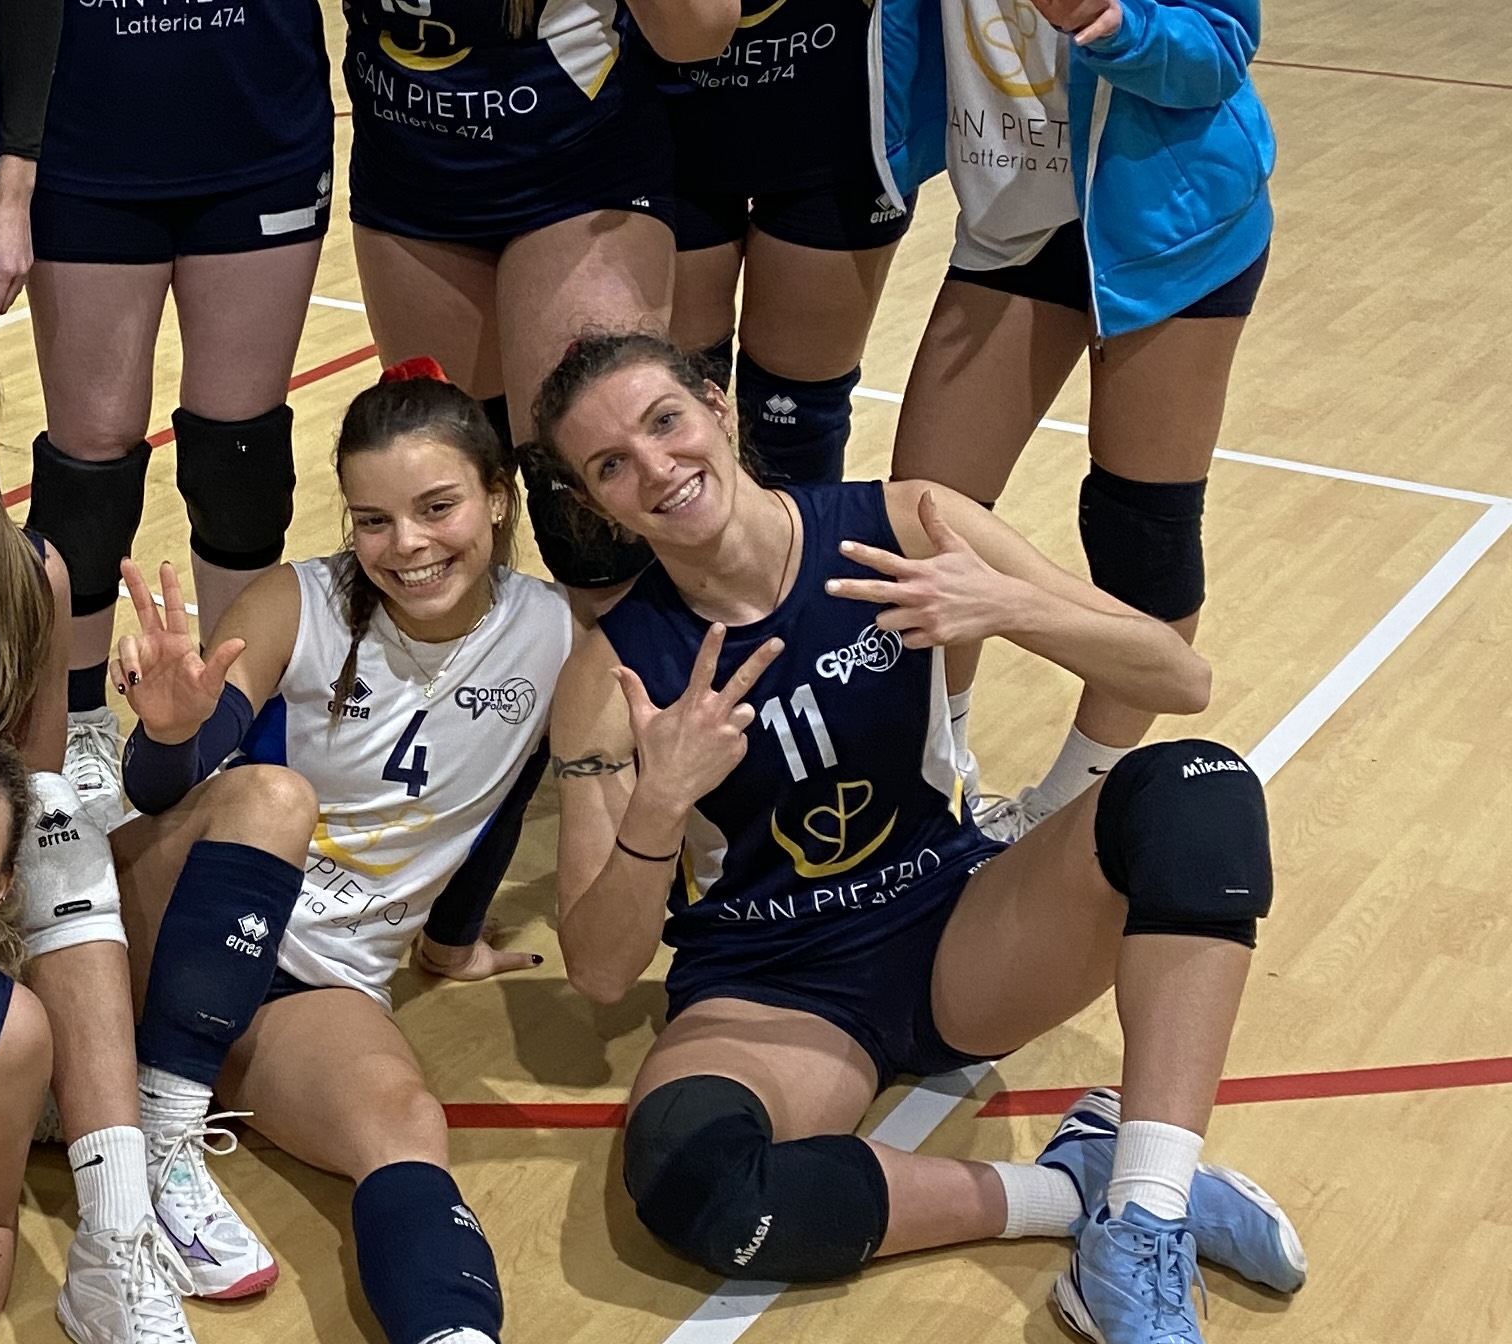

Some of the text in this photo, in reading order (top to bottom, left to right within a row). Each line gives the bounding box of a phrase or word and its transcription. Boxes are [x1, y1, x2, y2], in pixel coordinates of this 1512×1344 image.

[116, 7, 246, 36] Latteria 474
[717, 23, 836, 66] PIETRO
[356, 51, 538, 119] SAN PIETRO
[757, 63, 795, 84] 474
[456, 125, 494, 141] 474
[951, 106, 1069, 149] AN PIET
[960, 144, 1068, 174] Latteria 47
[327, 699, 371, 720] erea
[759, 683, 838, 783] 11
[381, 709, 430, 798] 4
[38, 829, 80, 848] errea
[718, 895, 795, 922] SAN
[226, 935, 264, 958] errea
